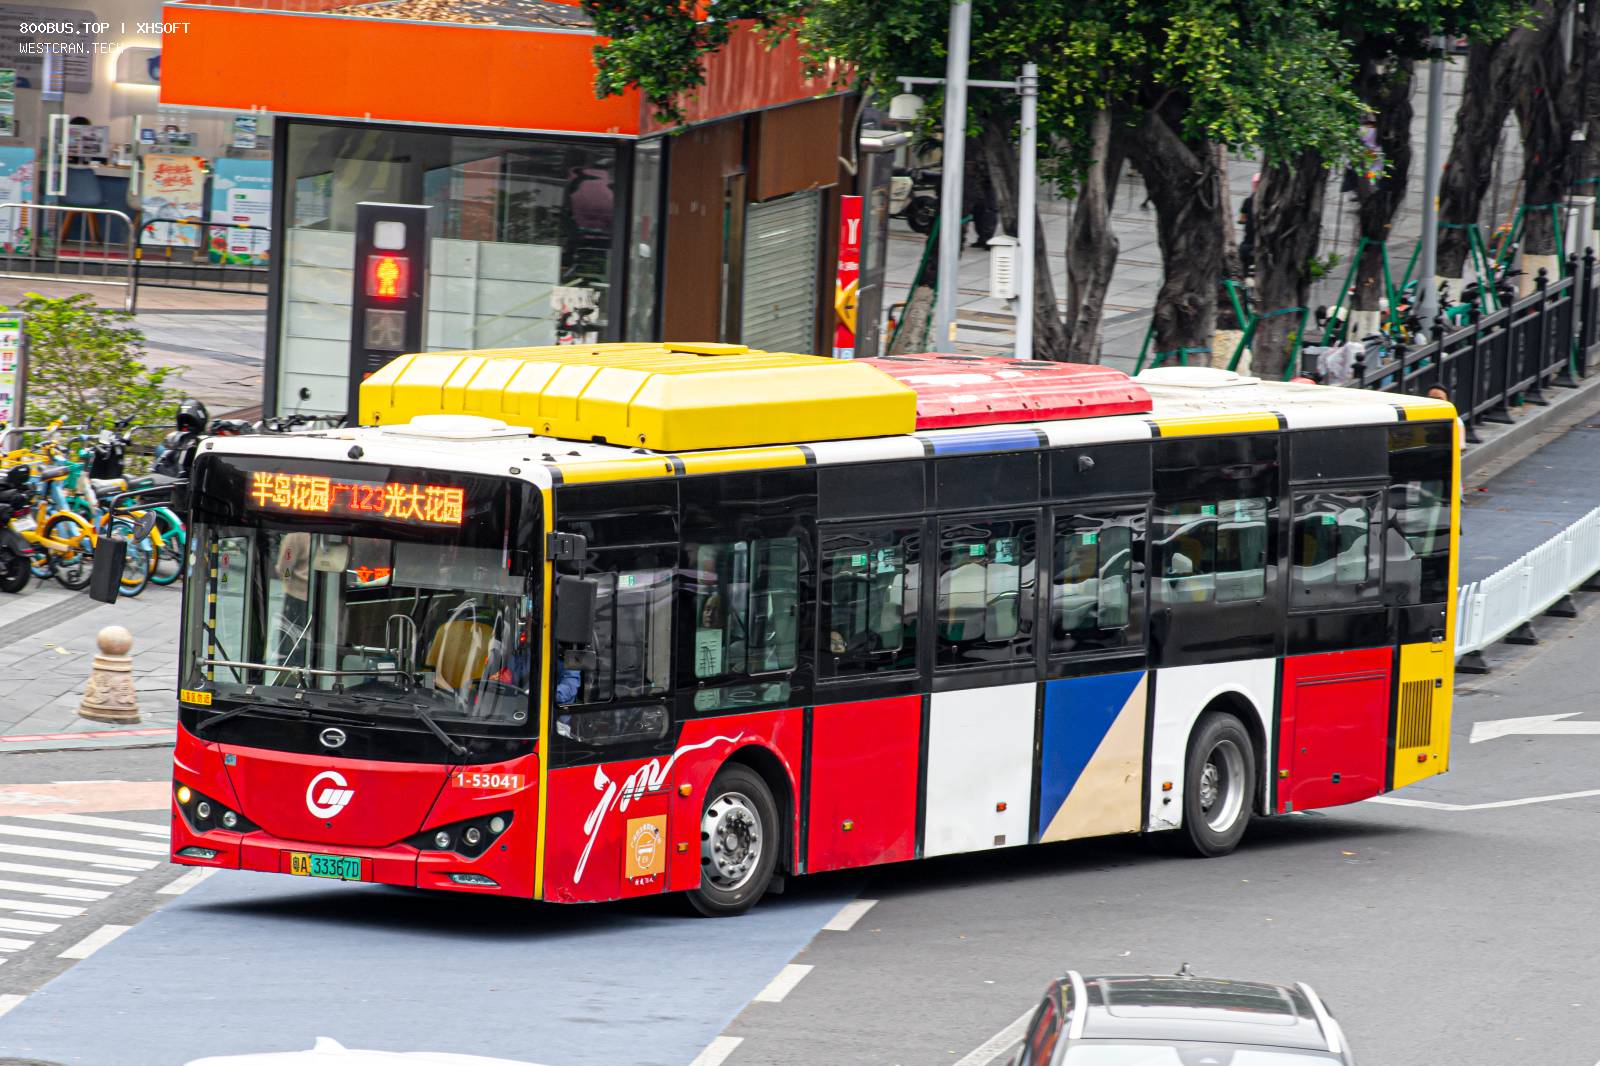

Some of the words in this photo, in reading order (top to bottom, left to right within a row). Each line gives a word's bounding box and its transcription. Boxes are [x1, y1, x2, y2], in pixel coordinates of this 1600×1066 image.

[251, 471, 331, 512] 半岛花园
[383, 482, 464, 524] 光大花园
[457, 773, 518, 789] 1-53041
